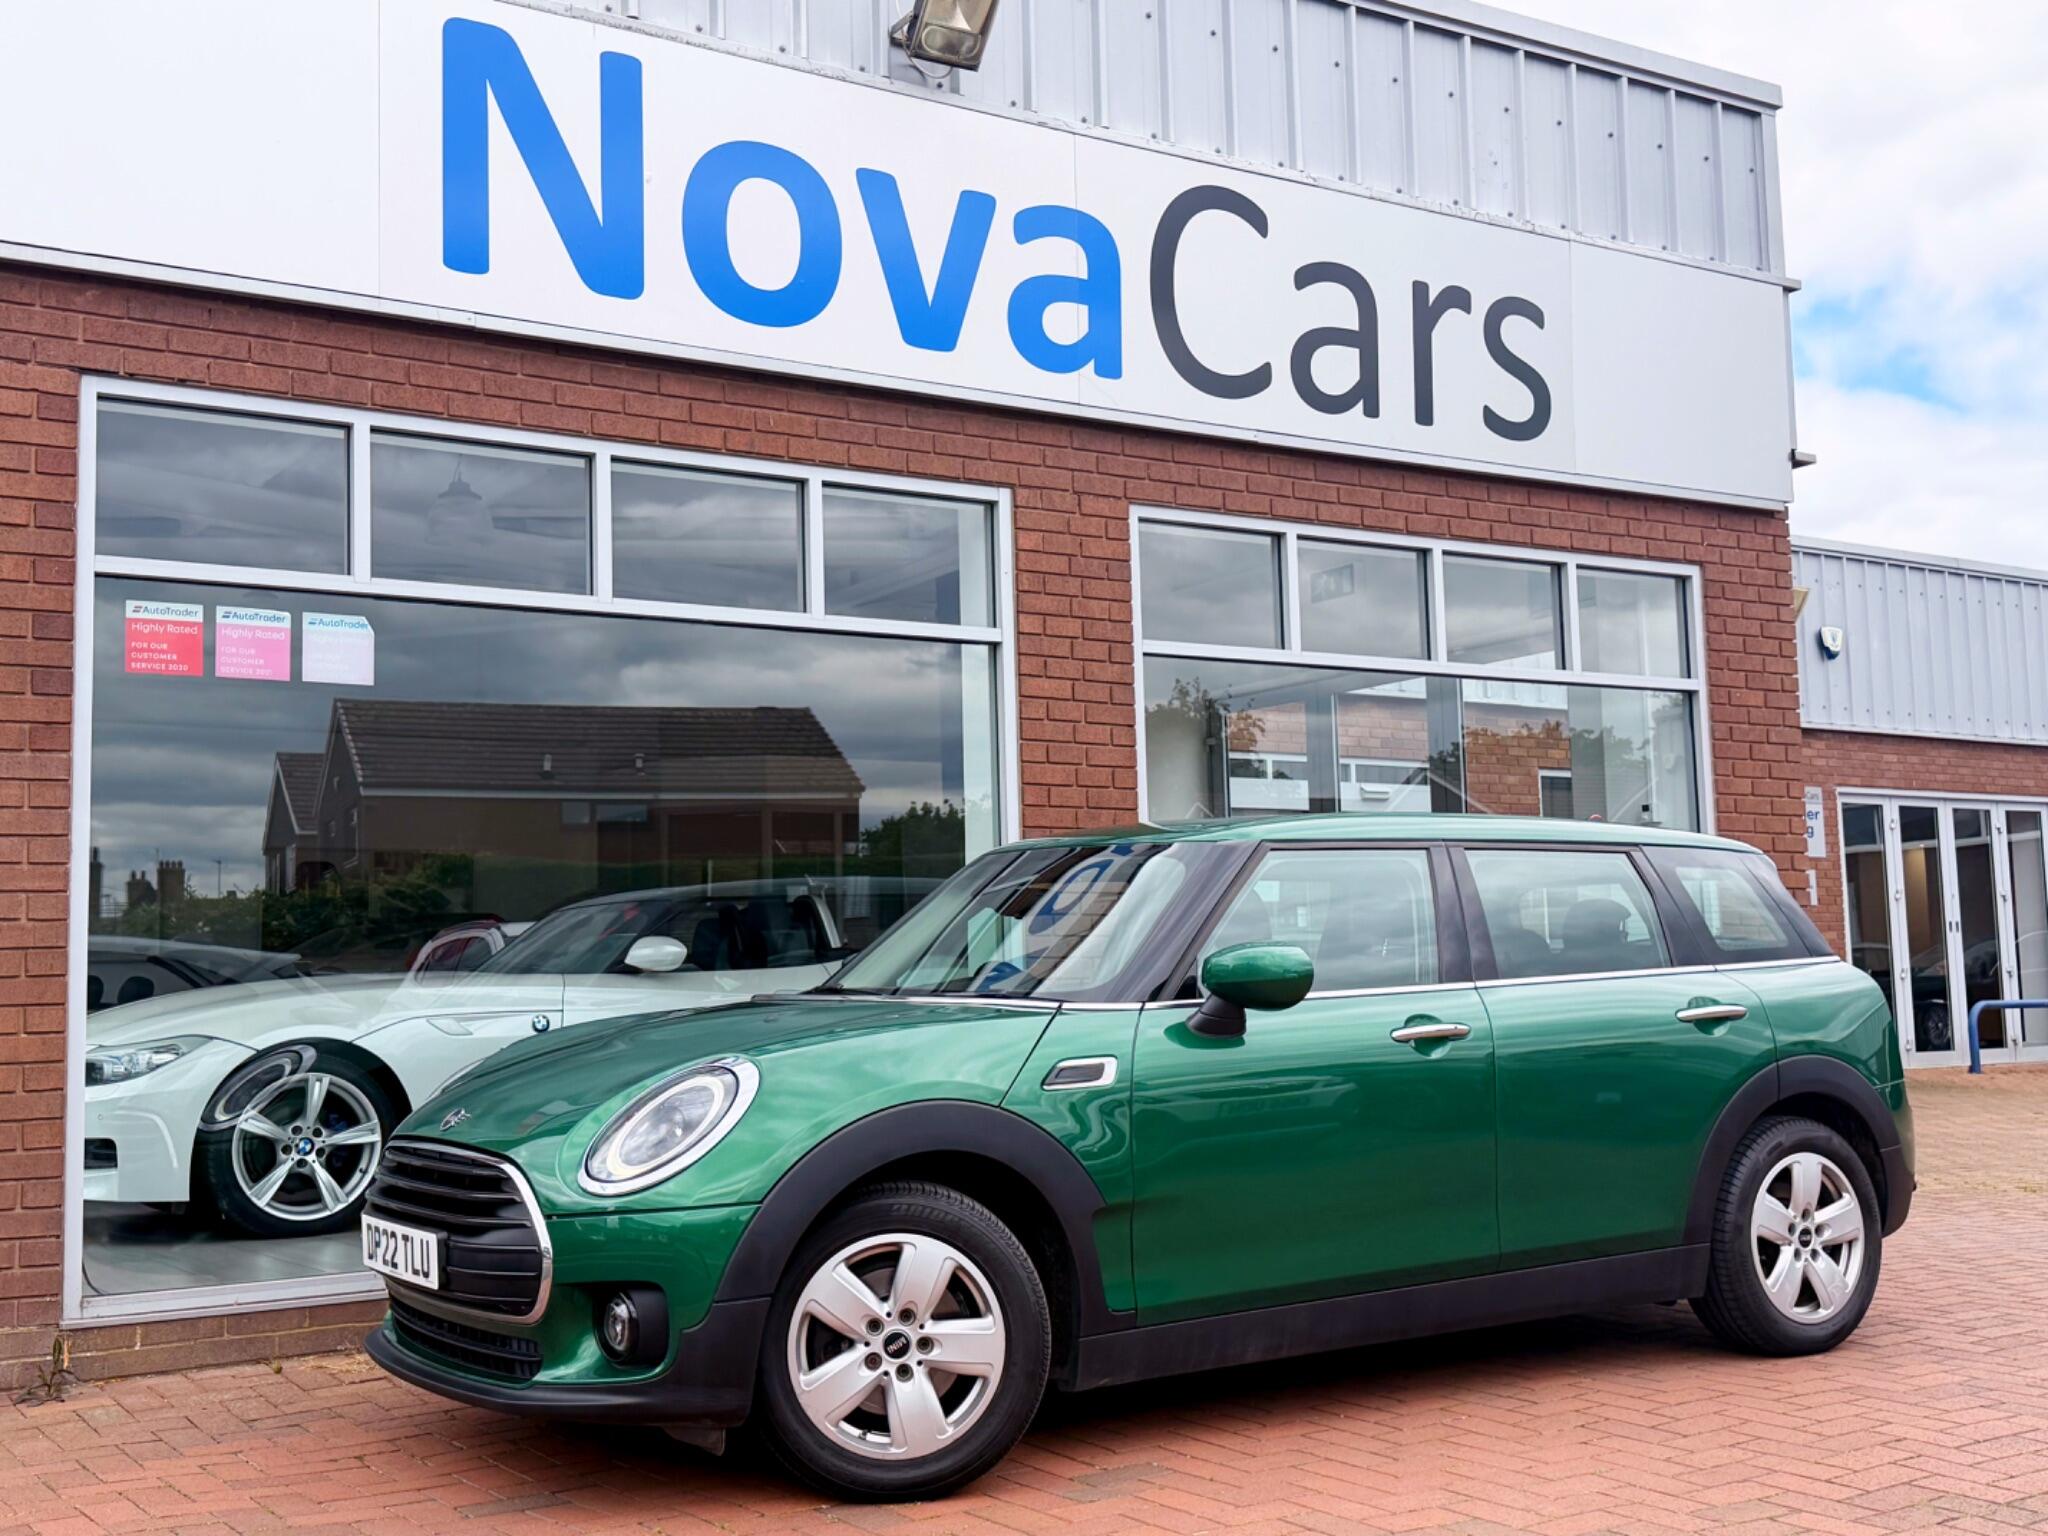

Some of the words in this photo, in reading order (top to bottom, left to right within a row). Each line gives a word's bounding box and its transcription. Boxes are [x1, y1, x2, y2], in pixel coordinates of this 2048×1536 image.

[441, 17, 1552, 442] NovaCars
[143, 606, 199, 618] AutoTrader
[232, 611, 286, 624] AutoTrader
[131, 621, 165, 635] Highly
[167, 623, 198, 635] Rated
[317, 617, 369, 631] AutoTrader
[221, 626, 254, 640] Highly
[255, 629, 285, 641] Rated
[131, 641, 149, 649] FOR
[150, 642, 168, 650] OUR
[131, 651, 177, 661] CUSTOMER
[131, 661, 166, 671] SERVICE
[367, 1223, 398, 1270] DP22
[401, 1234, 430, 1279] TLU
